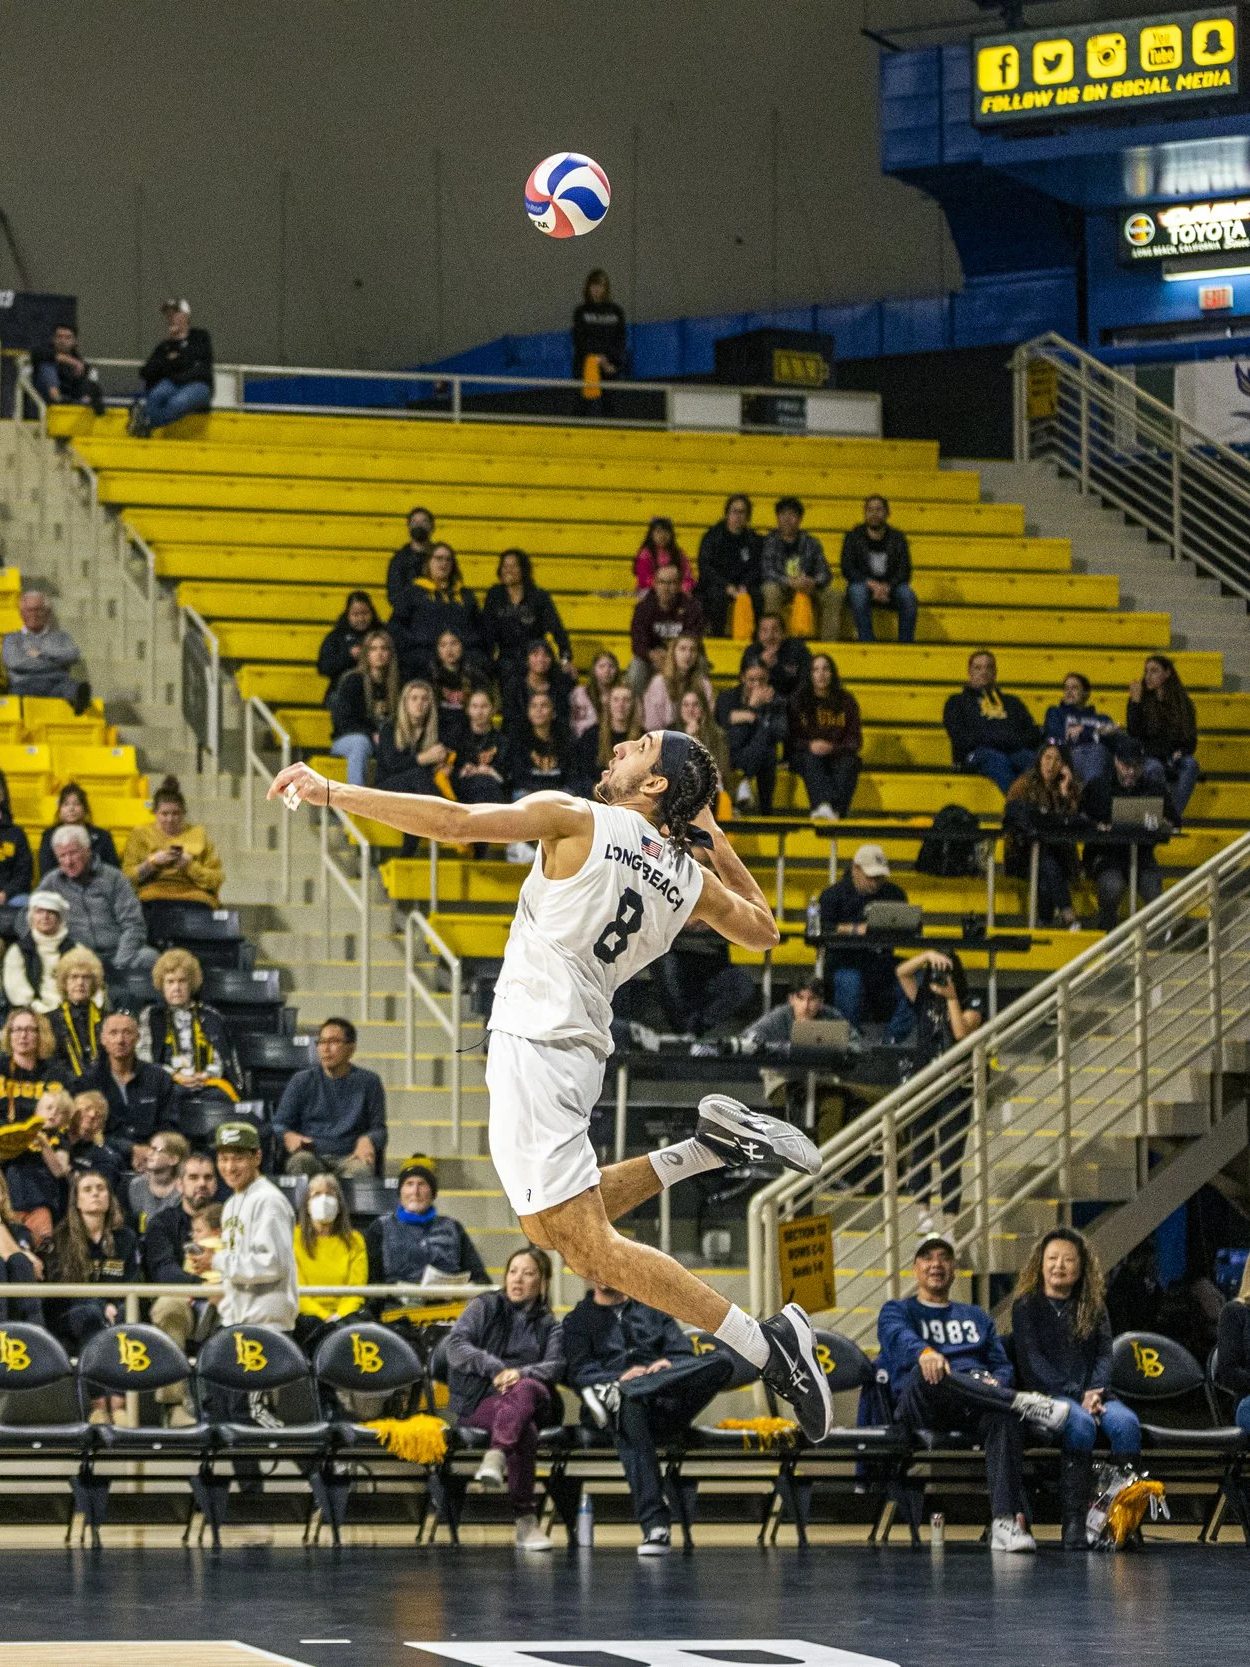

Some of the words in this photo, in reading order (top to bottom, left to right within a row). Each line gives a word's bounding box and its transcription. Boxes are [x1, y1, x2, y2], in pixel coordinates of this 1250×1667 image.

[980, 90, 1055, 114] FOLLOW
[1055, 86, 1080, 106] US
[1082, 82, 1109, 102] ON
[1110, 75, 1172, 99] SOCIAL
[1175, 68, 1232, 91] MEDIA
[1167, 219, 1247, 245] TOYOTA
[593, 887, 645, 964] 8
[921, 1319, 982, 1344] 1983
[815, 1344, 836, 1374] B
